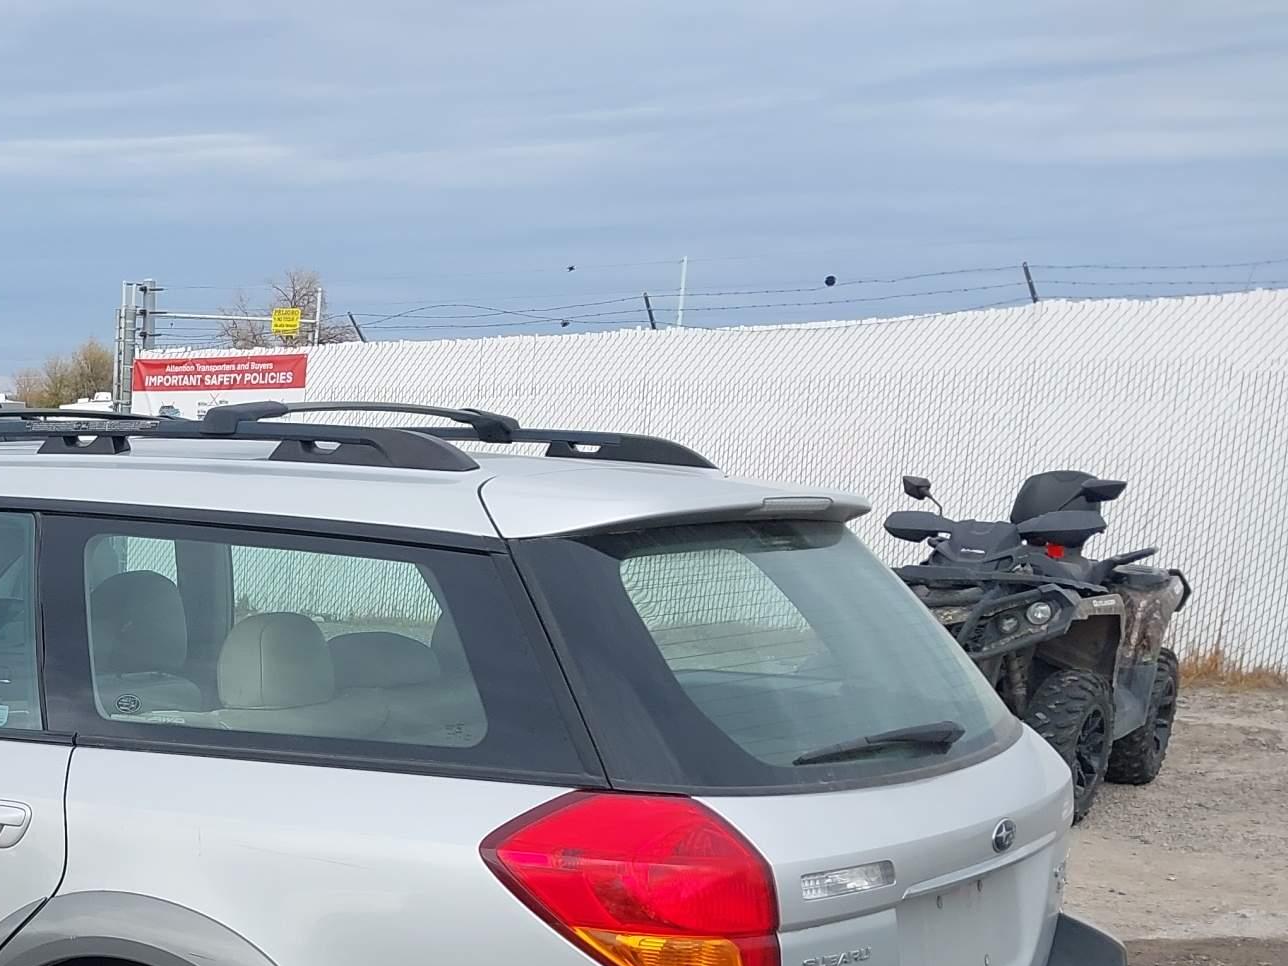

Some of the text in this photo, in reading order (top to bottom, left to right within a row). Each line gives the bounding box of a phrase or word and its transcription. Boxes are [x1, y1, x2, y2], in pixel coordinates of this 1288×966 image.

[165, 362, 273, 373] Attention Transporters and Buyers
[144, 371, 294, 387] IMPORTANT SAFETY POLICIES
